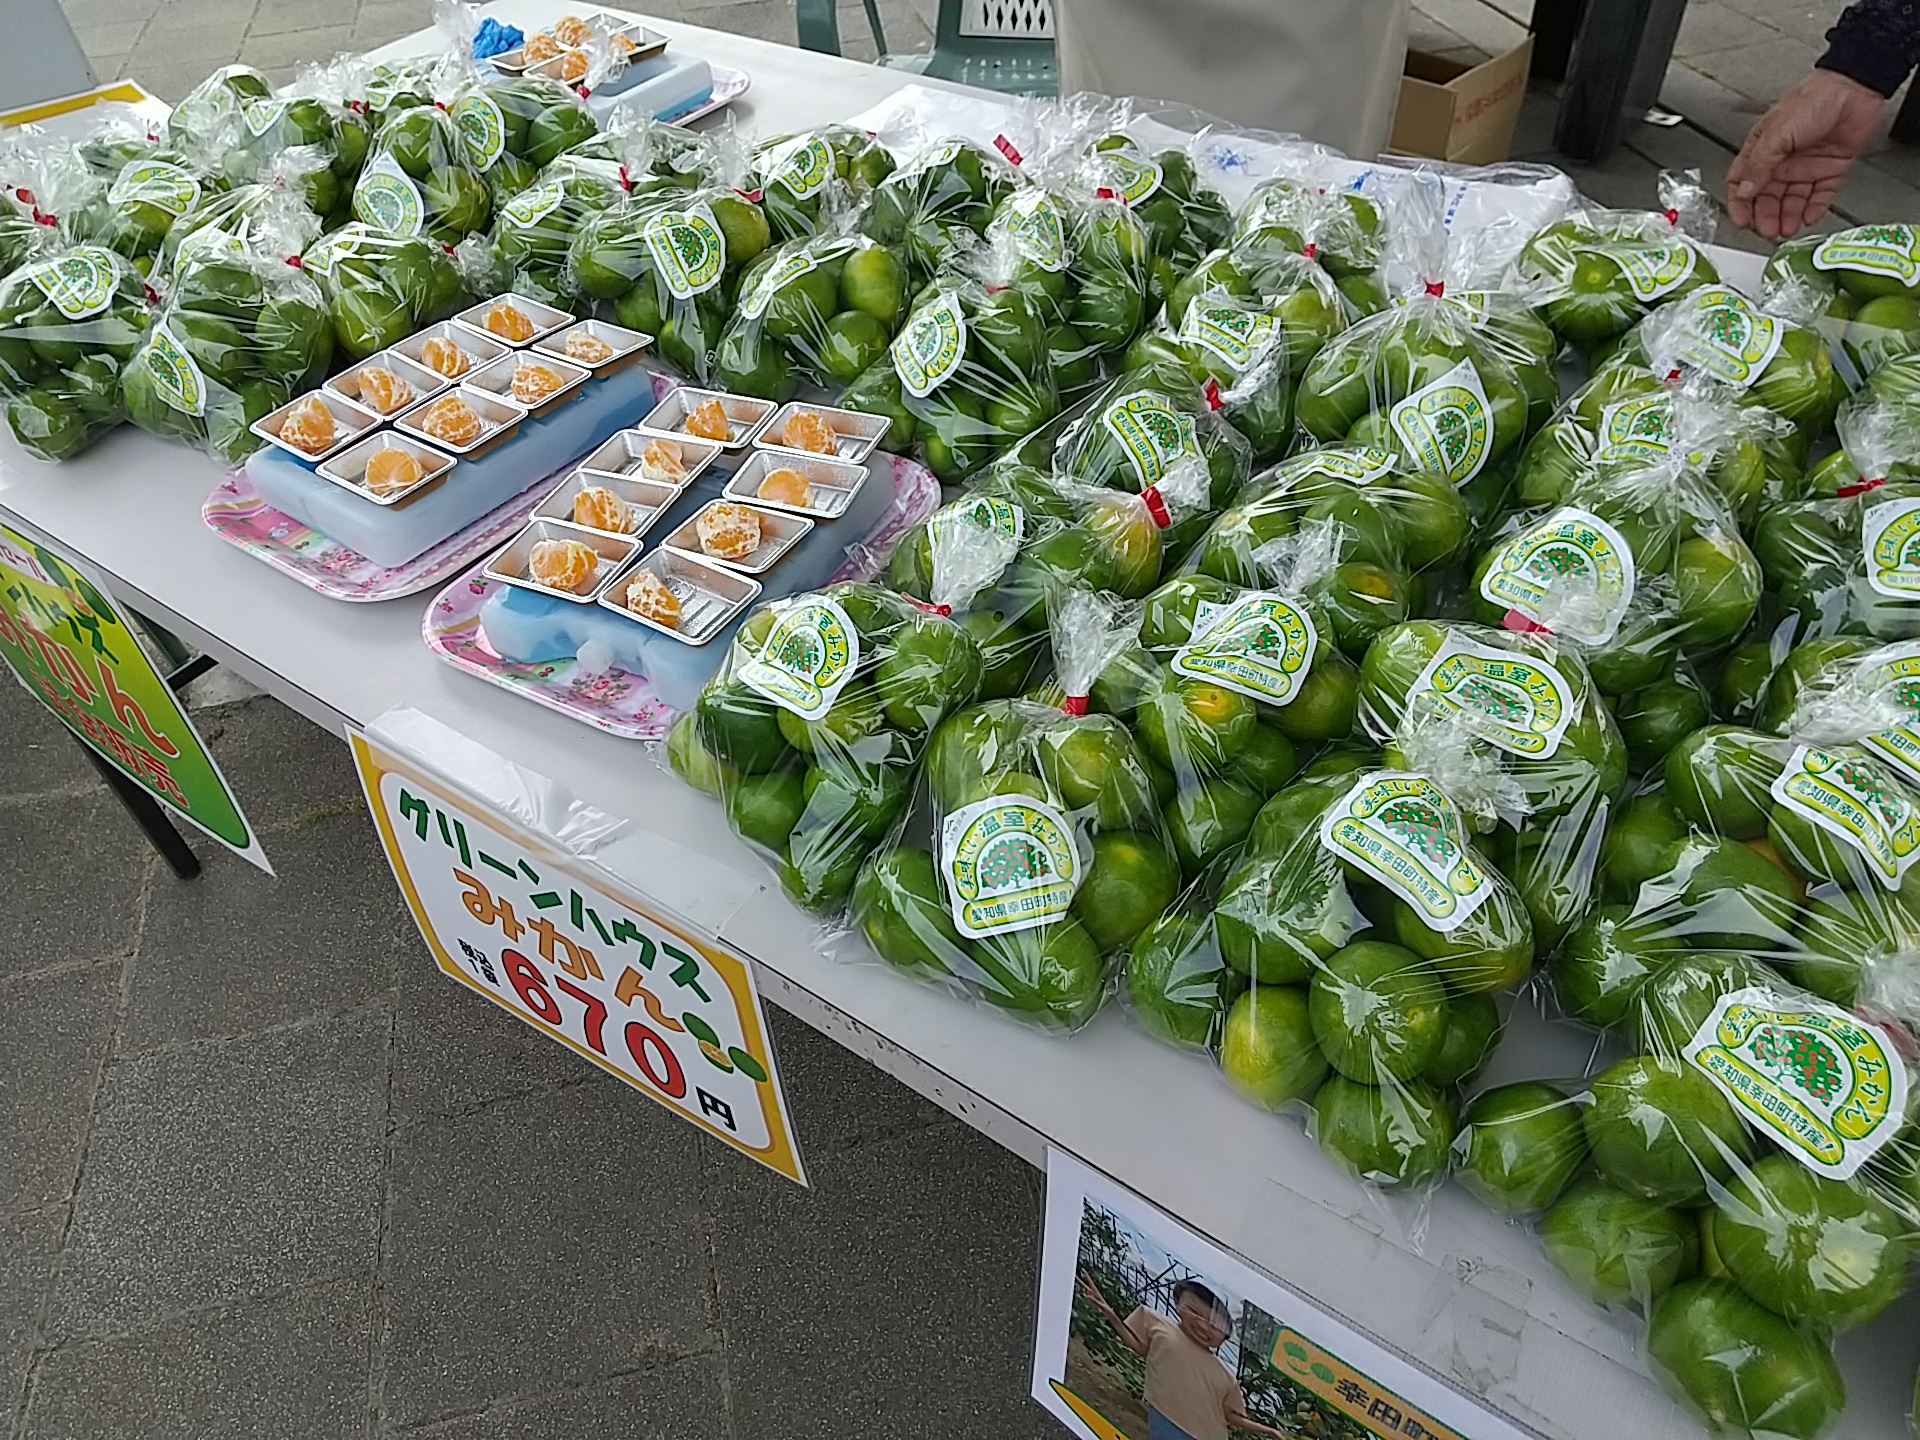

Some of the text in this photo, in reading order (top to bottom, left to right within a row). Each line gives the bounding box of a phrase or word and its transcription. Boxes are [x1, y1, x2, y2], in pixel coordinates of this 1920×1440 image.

[1187, 657, 1286, 691] 愛知県幸田町特産!
[400, 787, 712, 1004] グリーンハウス
[956, 810, 1070, 891] 美味しい温室みかん
[1339, 824, 1449, 908] 愛知県幸田町特産!
[452, 866, 687, 1034] みかん
[971, 888, 1074, 923] 愛知県幸田町特産!
[1707, 1053, 1835, 1153] 愛知県幸田町特産!
[1726, 1008, 1885, 1125] 美味しい温室みかん
